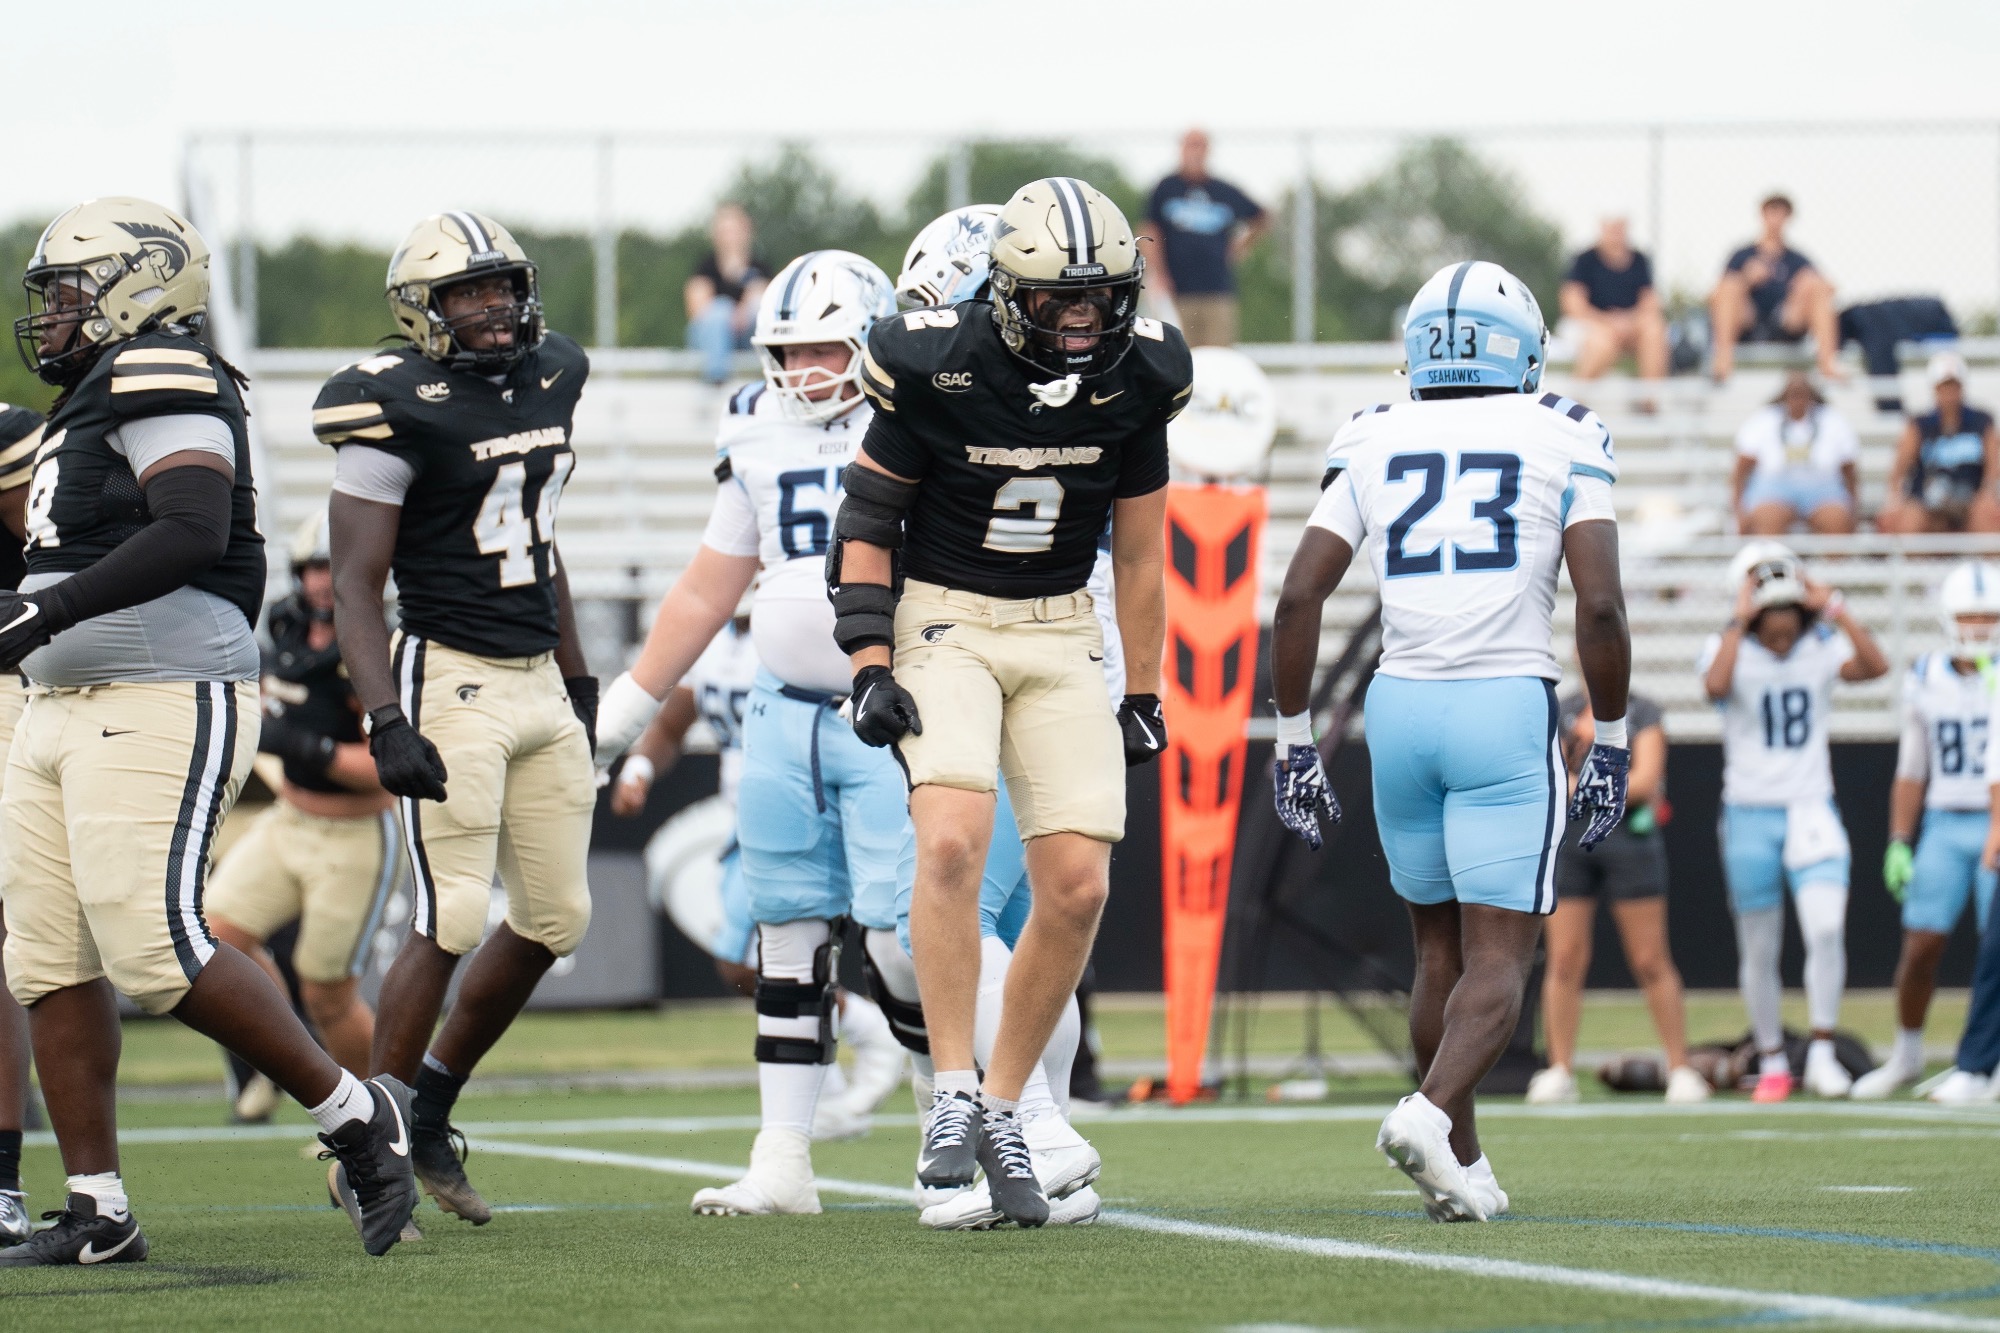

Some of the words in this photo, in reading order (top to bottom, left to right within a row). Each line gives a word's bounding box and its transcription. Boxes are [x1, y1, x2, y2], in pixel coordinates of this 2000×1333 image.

[470, 251, 505, 263] TROJANS
[1065, 266, 1104, 277] TROJANS
[1428, 326, 1477, 360] 23
[1066, 354, 1093, 364] Riddell
[420, 381, 450, 398] SAC
[938, 371, 973, 388] SAC
[1428, 369, 1480, 384] SEAHAWKS
[470, 426, 566, 462] TROJANS
[818, 441, 849, 455] KEISER
[965, 445, 1103, 471] TROJANS
[472, 451, 574, 589] 44
[778, 466, 847, 562] 6
[981, 476, 1065, 553] 2
[1384, 449, 1524, 581] 23
[1763, 686, 1810, 748] 18
